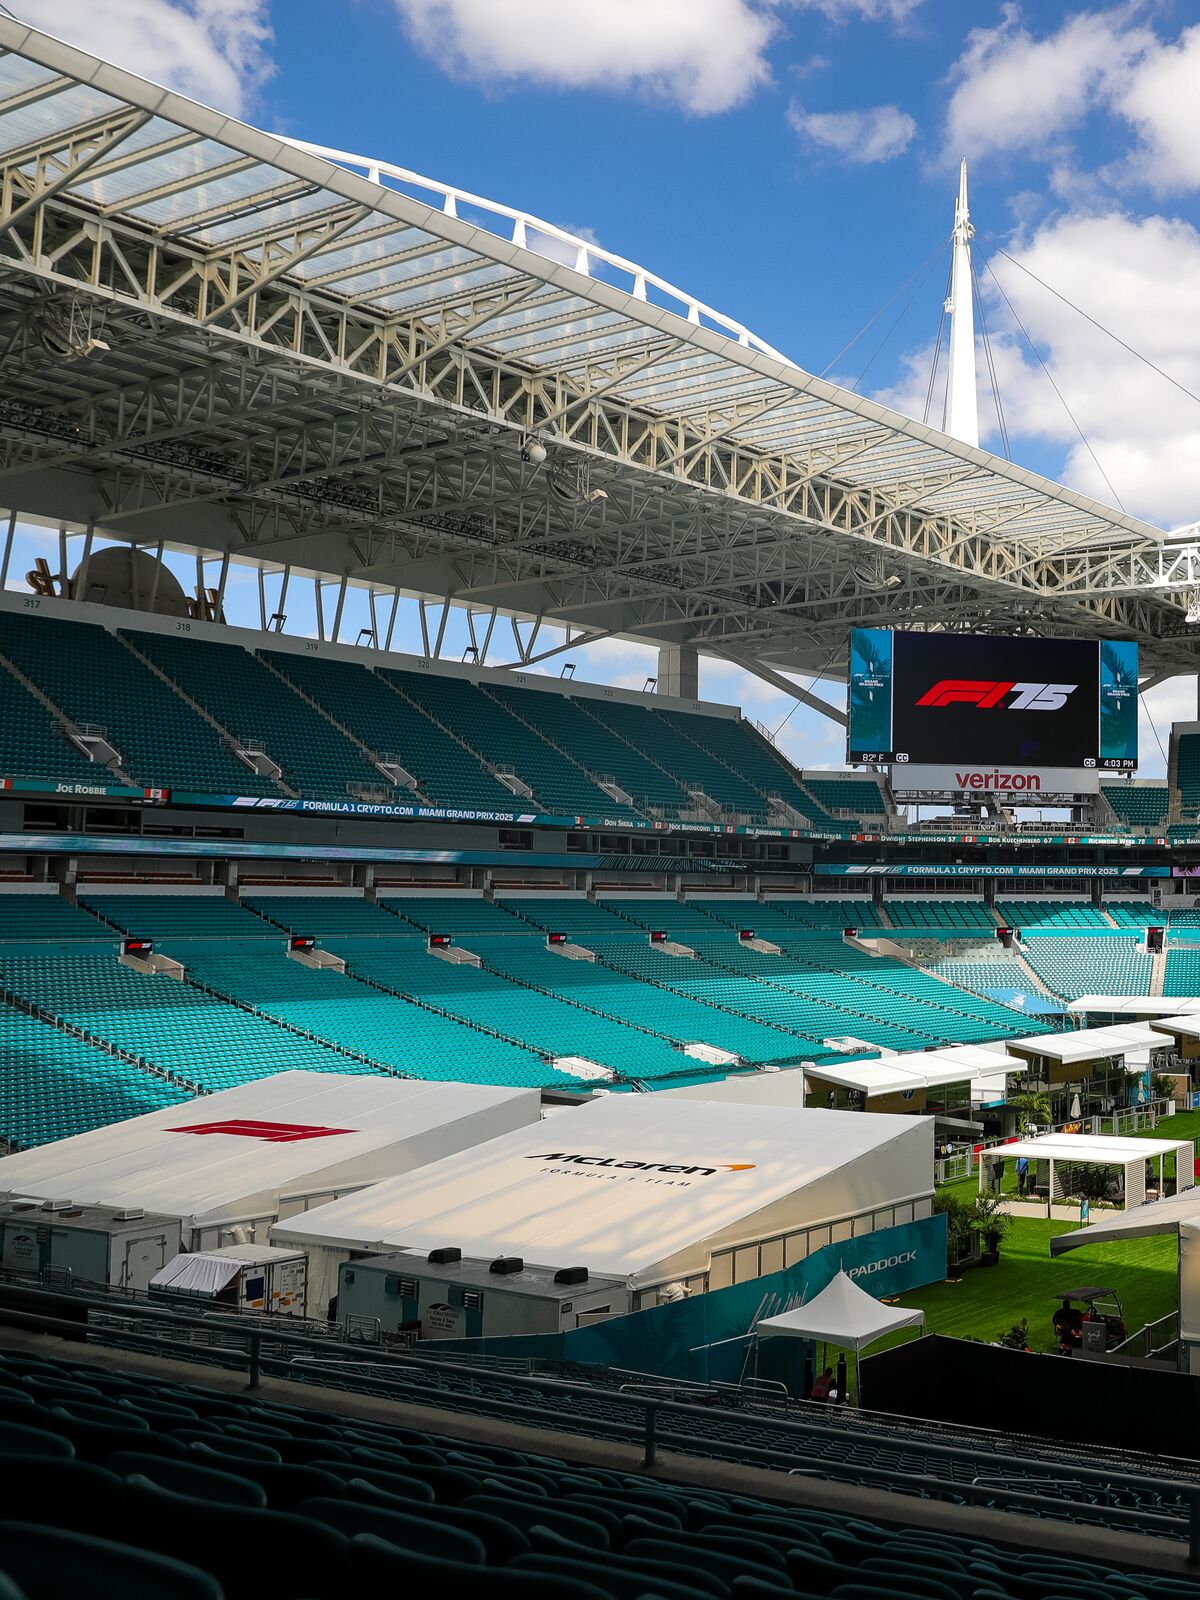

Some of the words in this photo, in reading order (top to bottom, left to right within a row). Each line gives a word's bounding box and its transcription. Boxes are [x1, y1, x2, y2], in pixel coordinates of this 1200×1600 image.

[24, 599, 41, 609] 317
[176, 622, 191, 632] 318
[305, 643, 318, 651] 319
[417, 660, 430, 669] 320
[516, 676, 526, 684] 321
[603, 689, 614, 697] 322
[878, 753, 884, 762] F
[1104, 759, 1121, 767] 4:03
[1123, 759, 1134, 768] PM
[955, 769, 1041, 790] verizon
[55, 783, 73, 794] JOE
[75, 784, 107, 796] ROBBIE
[303, 800, 349, 812] FORMULA
[350, 803, 356, 812] 1
[357, 804, 414, 815] CRYPTO.COM
[418, 809, 446, 818] MIAMI
[446, 809, 475, 819] GRAND
[476, 811, 494, 820] PRIX
[495, 812, 514, 821] 2025
[907, 866, 949, 874] FORMULA
[958, 866, 1013, 874] CRYPTO.COM
[1018, 867, 1046, 875] MIAMI
[1046, 867, 1079, 875] GRAND
[522, 1152, 718, 1176] McLaren
[540, 1167, 617, 1180] FORMULA
[645, 1178, 692, 1187] TEAM
[849, 1250, 917, 1279] PADDOCK
